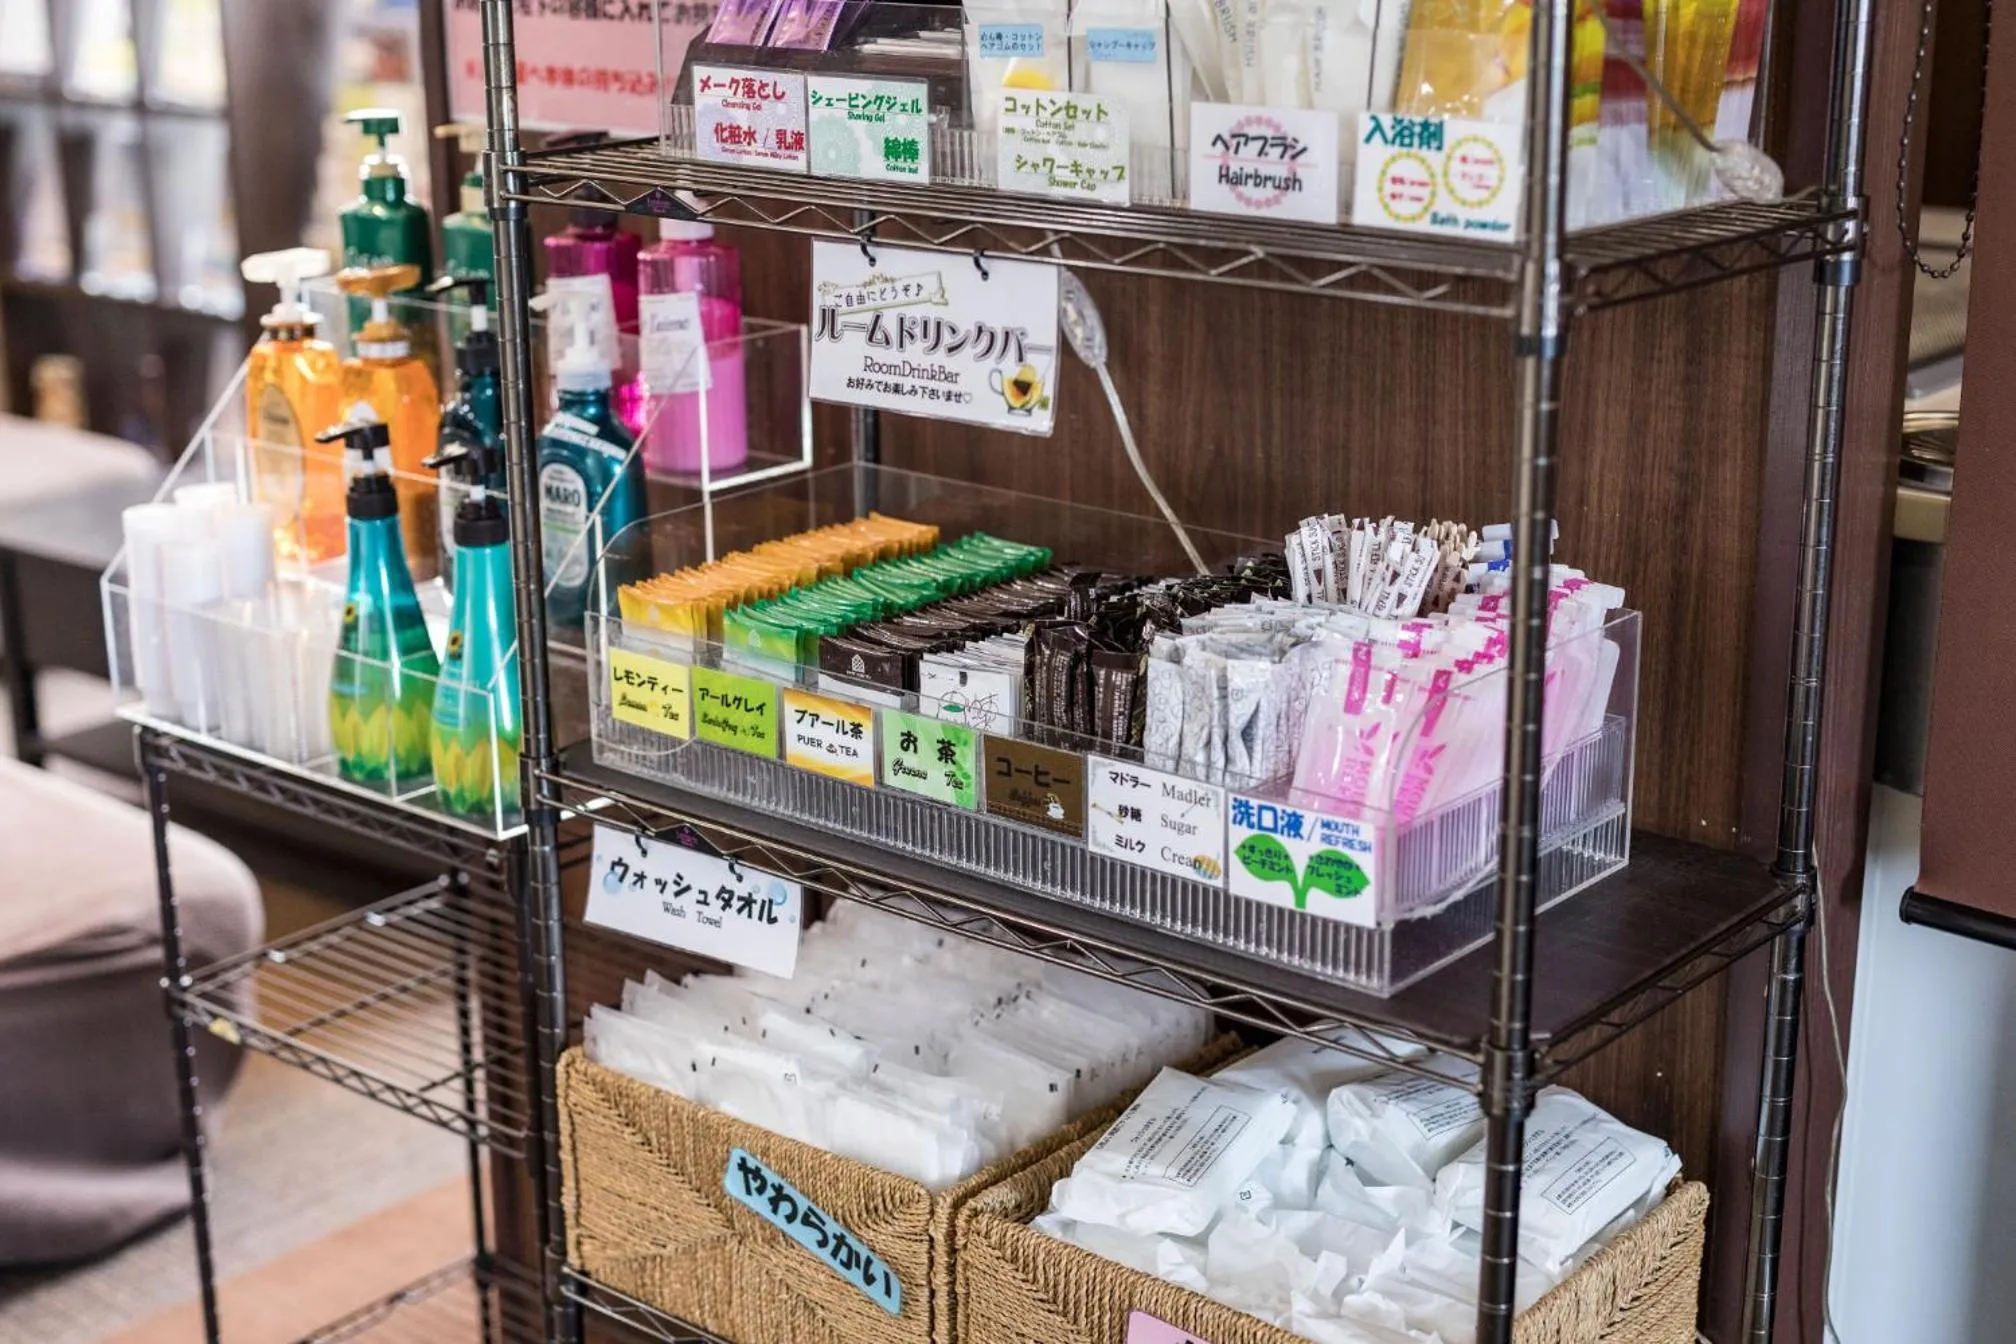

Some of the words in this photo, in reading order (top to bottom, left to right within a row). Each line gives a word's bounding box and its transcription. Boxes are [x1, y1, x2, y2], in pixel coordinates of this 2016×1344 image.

[699, 74, 787, 101] メーク落とし
[810, 89, 922, 114] シェービングジェル
[1004, 96, 1109, 122] コットンセット
[713, 121, 758, 147] 化粧水
[775, 128, 806, 151] 乳液
[1363, 114, 1445, 152] 入浴剤
[1015, 154, 1126, 182] シャワーキャップ
[1218, 164, 1304, 193] Hairbrush
[1080, 179, 1097, 192] Cap
[815, 305, 1054, 363] ルームドリンクバー
[613, 667, 684, 694] レモンティー
[698, 687, 767, 717] アールグレイ
[797, 734, 823, 748] PUER
[838, 745, 859, 758] TEA
[900, 730, 957, 765] お茶
[995, 756, 1072, 788] コーヒー
[1108, 770, 1152, 789] マドラー
[1162, 782, 1212, 808] Madler
[1117, 804, 1142, 823] 砂糖
[1161, 813, 1199, 836] Sugar
[1231, 797, 1304, 840] 洗口液
[1114, 834, 1146, 853] ミルク
[609, 857, 779, 925] ウォッシュタオル
[662, 891, 686, 919] Wash
[696, 910, 723, 929] Towel
[736, 1155, 892, 1299] やわらかい
